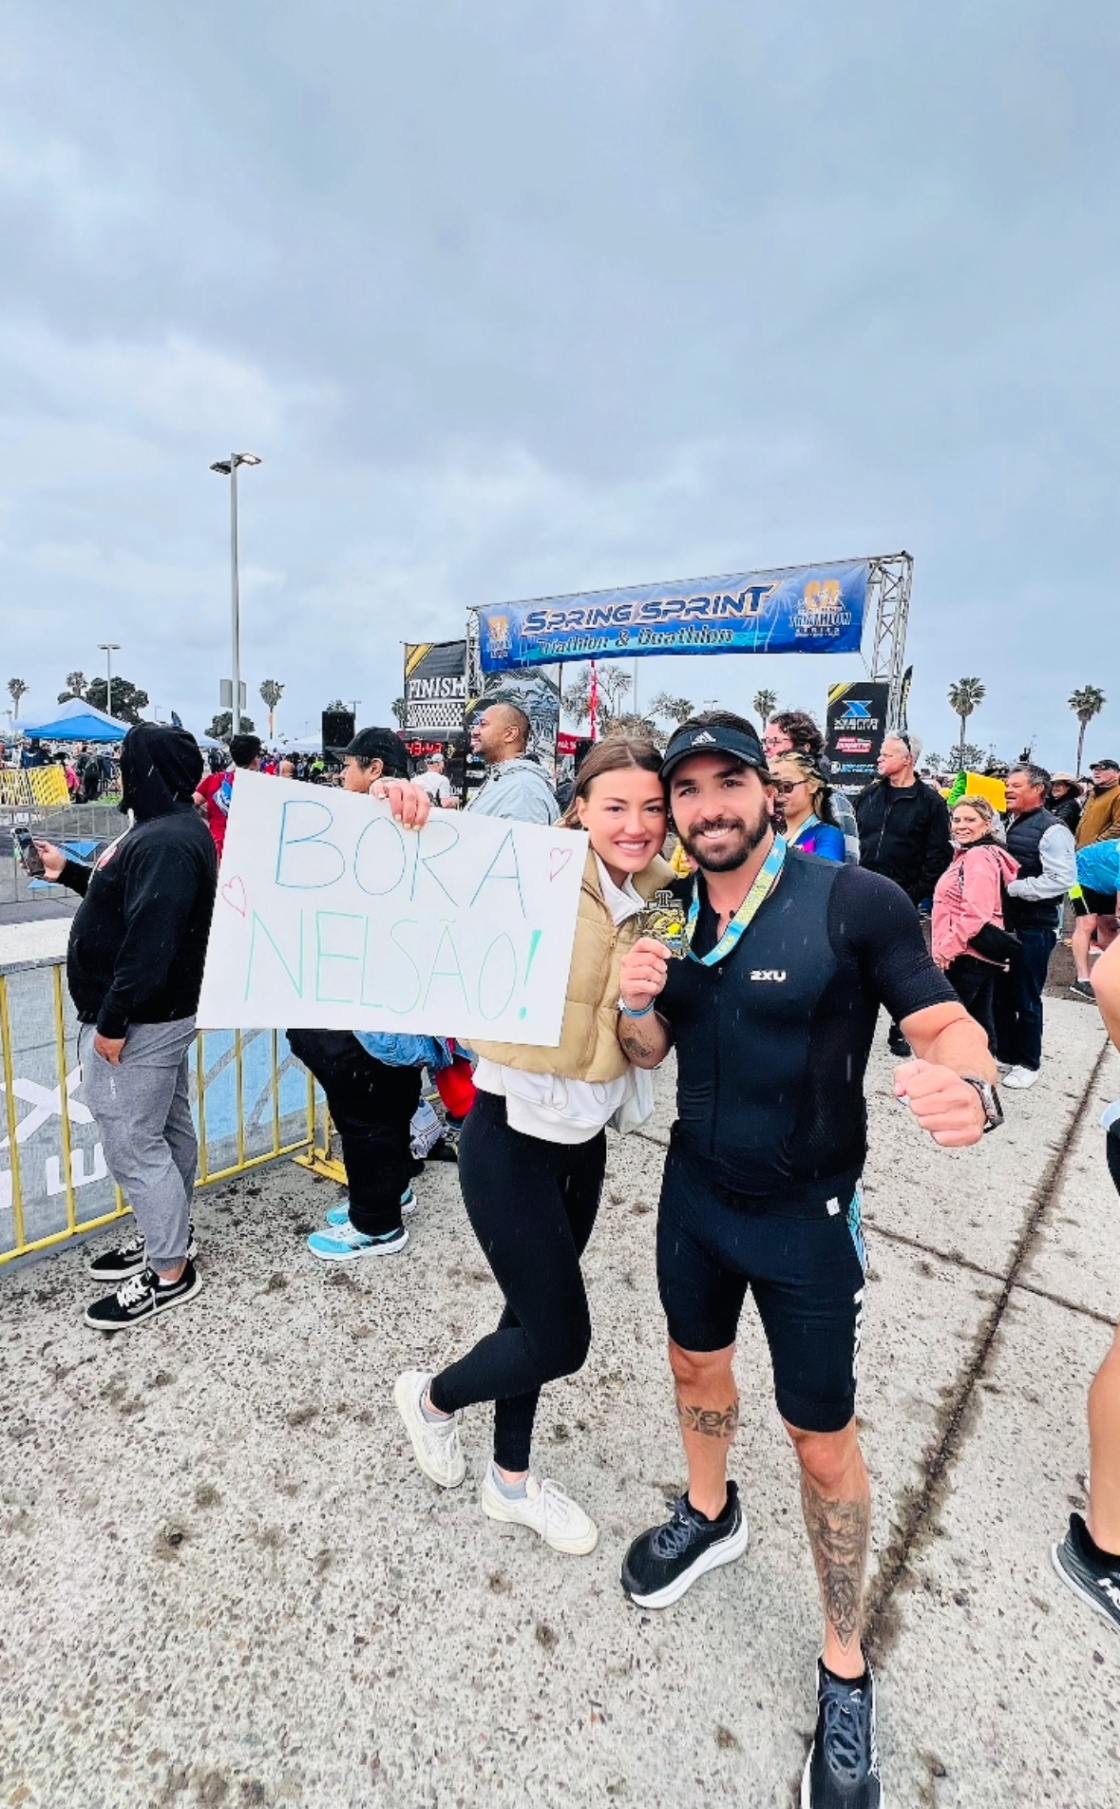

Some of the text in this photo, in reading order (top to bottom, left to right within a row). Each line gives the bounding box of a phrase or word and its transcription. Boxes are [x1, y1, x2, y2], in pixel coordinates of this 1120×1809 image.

[522, 581, 782, 636] SPRING SPRINT
[536, 633, 608, 655] Triathlon
[614, 629, 630, 647] &
[637, 625, 734, 646] Duathlon
[408, 676, 466, 699] FINISH
[275, 800, 526, 918] BORA
[244, 908, 542, 1021] NELSÃO!
[750, 969, 787, 982] 2XU
